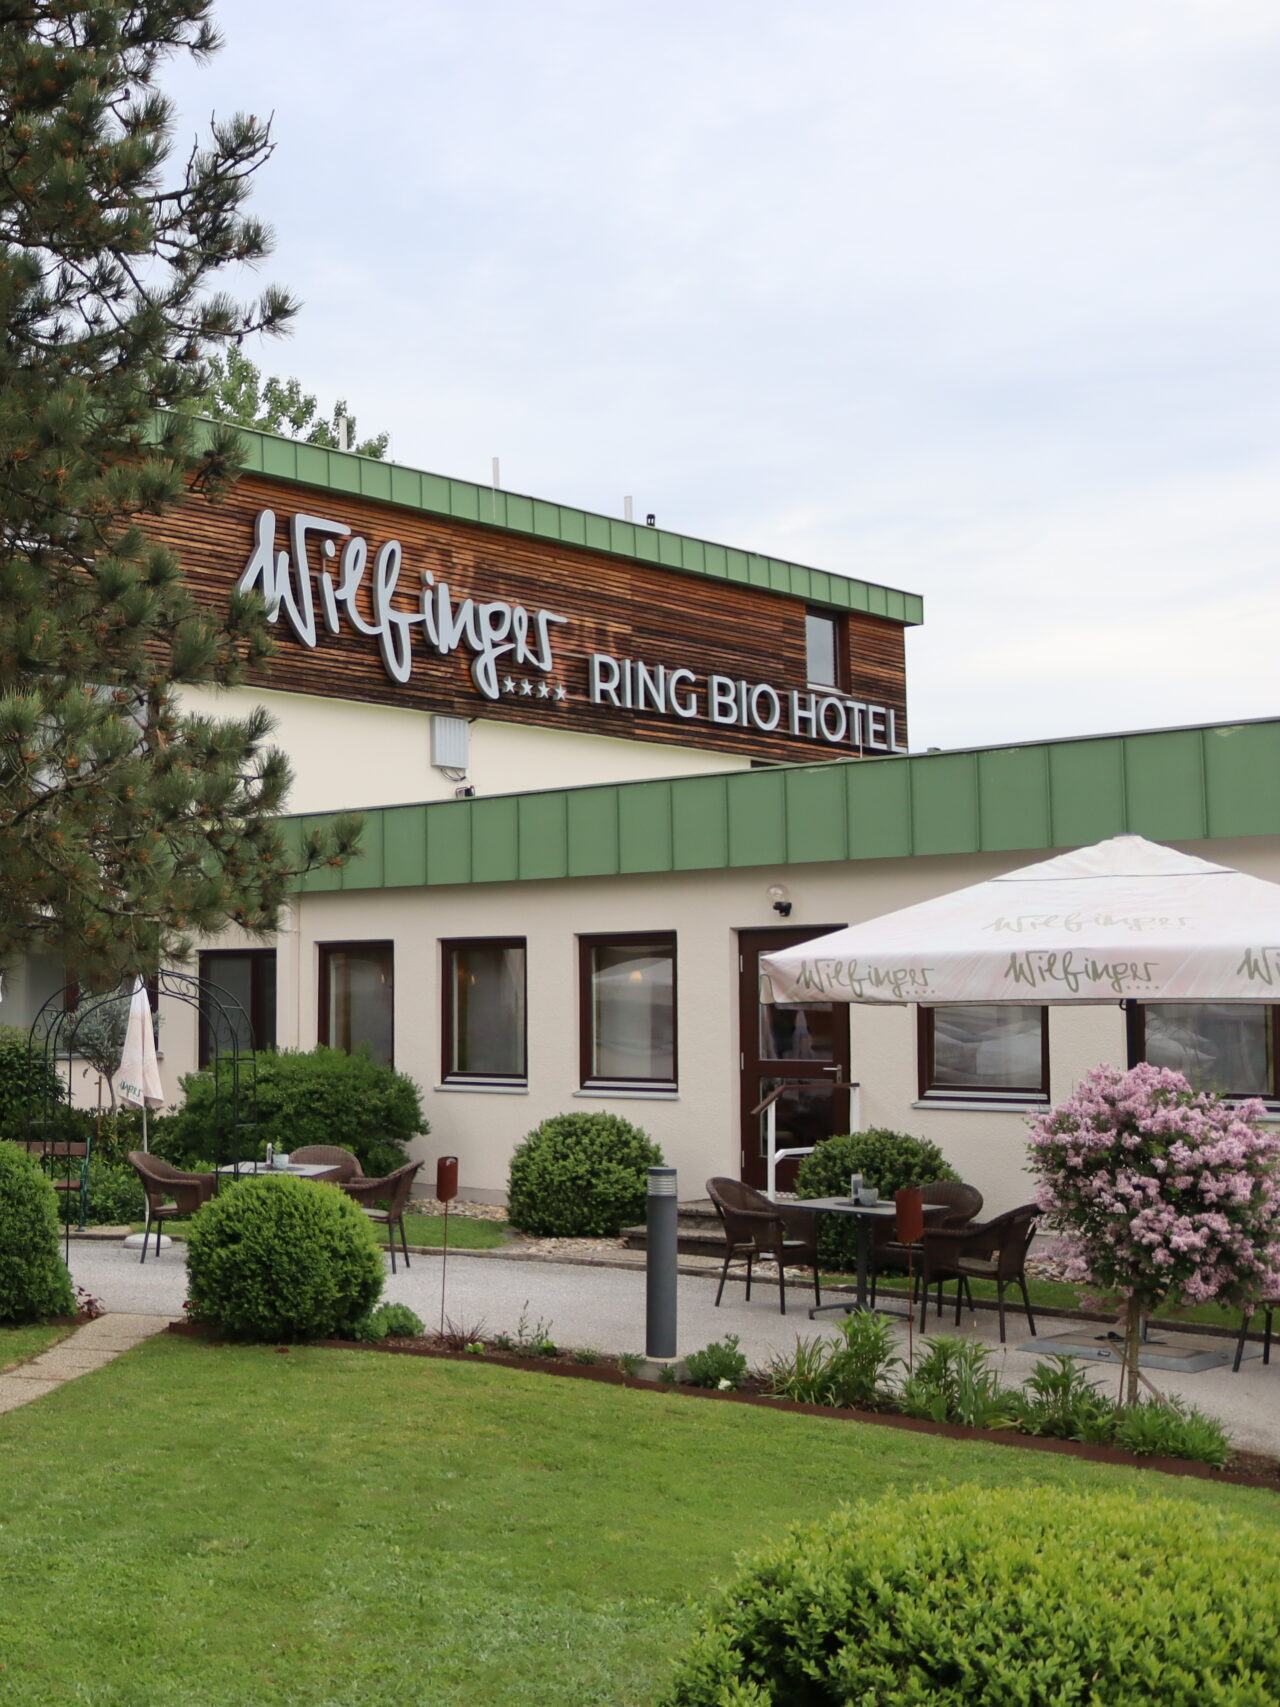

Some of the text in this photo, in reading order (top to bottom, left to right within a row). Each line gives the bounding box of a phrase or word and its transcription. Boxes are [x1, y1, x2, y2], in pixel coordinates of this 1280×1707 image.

[238, 509, 568, 700] Wilfinger
[589, 653, 908, 754] RING BIO HOTEL
[796, 958, 935, 998] Wilfinger
[1004, 950, 1160, 993] Wilfinger
